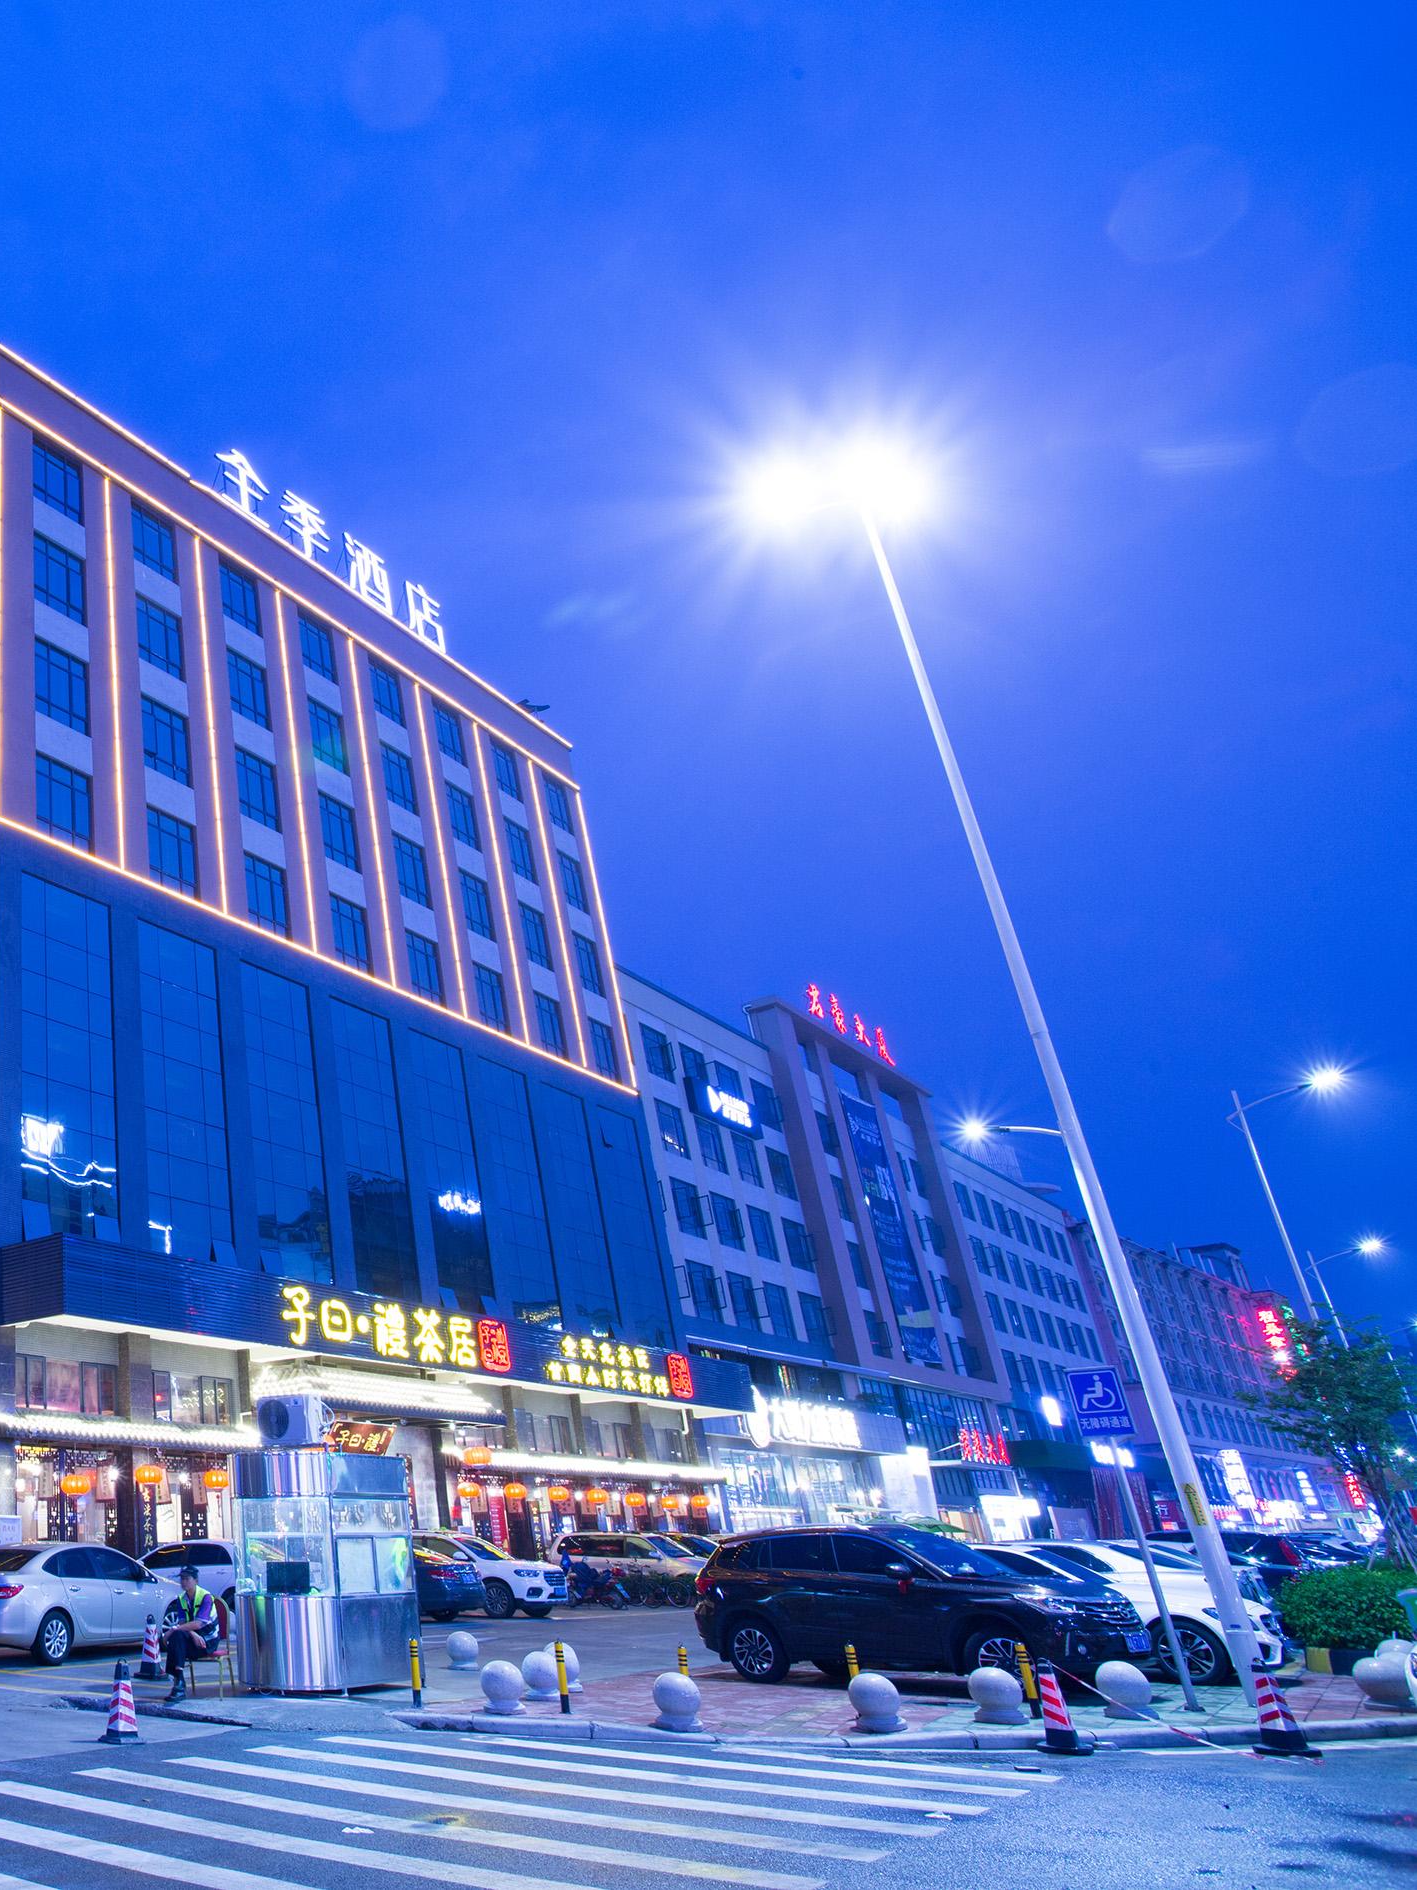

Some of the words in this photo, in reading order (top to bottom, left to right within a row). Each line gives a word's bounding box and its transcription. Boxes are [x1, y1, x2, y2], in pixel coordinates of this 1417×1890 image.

[215, 448, 446, 655] 全季酒店
[1080, 1415, 1131, 1430] 无障碍通道
